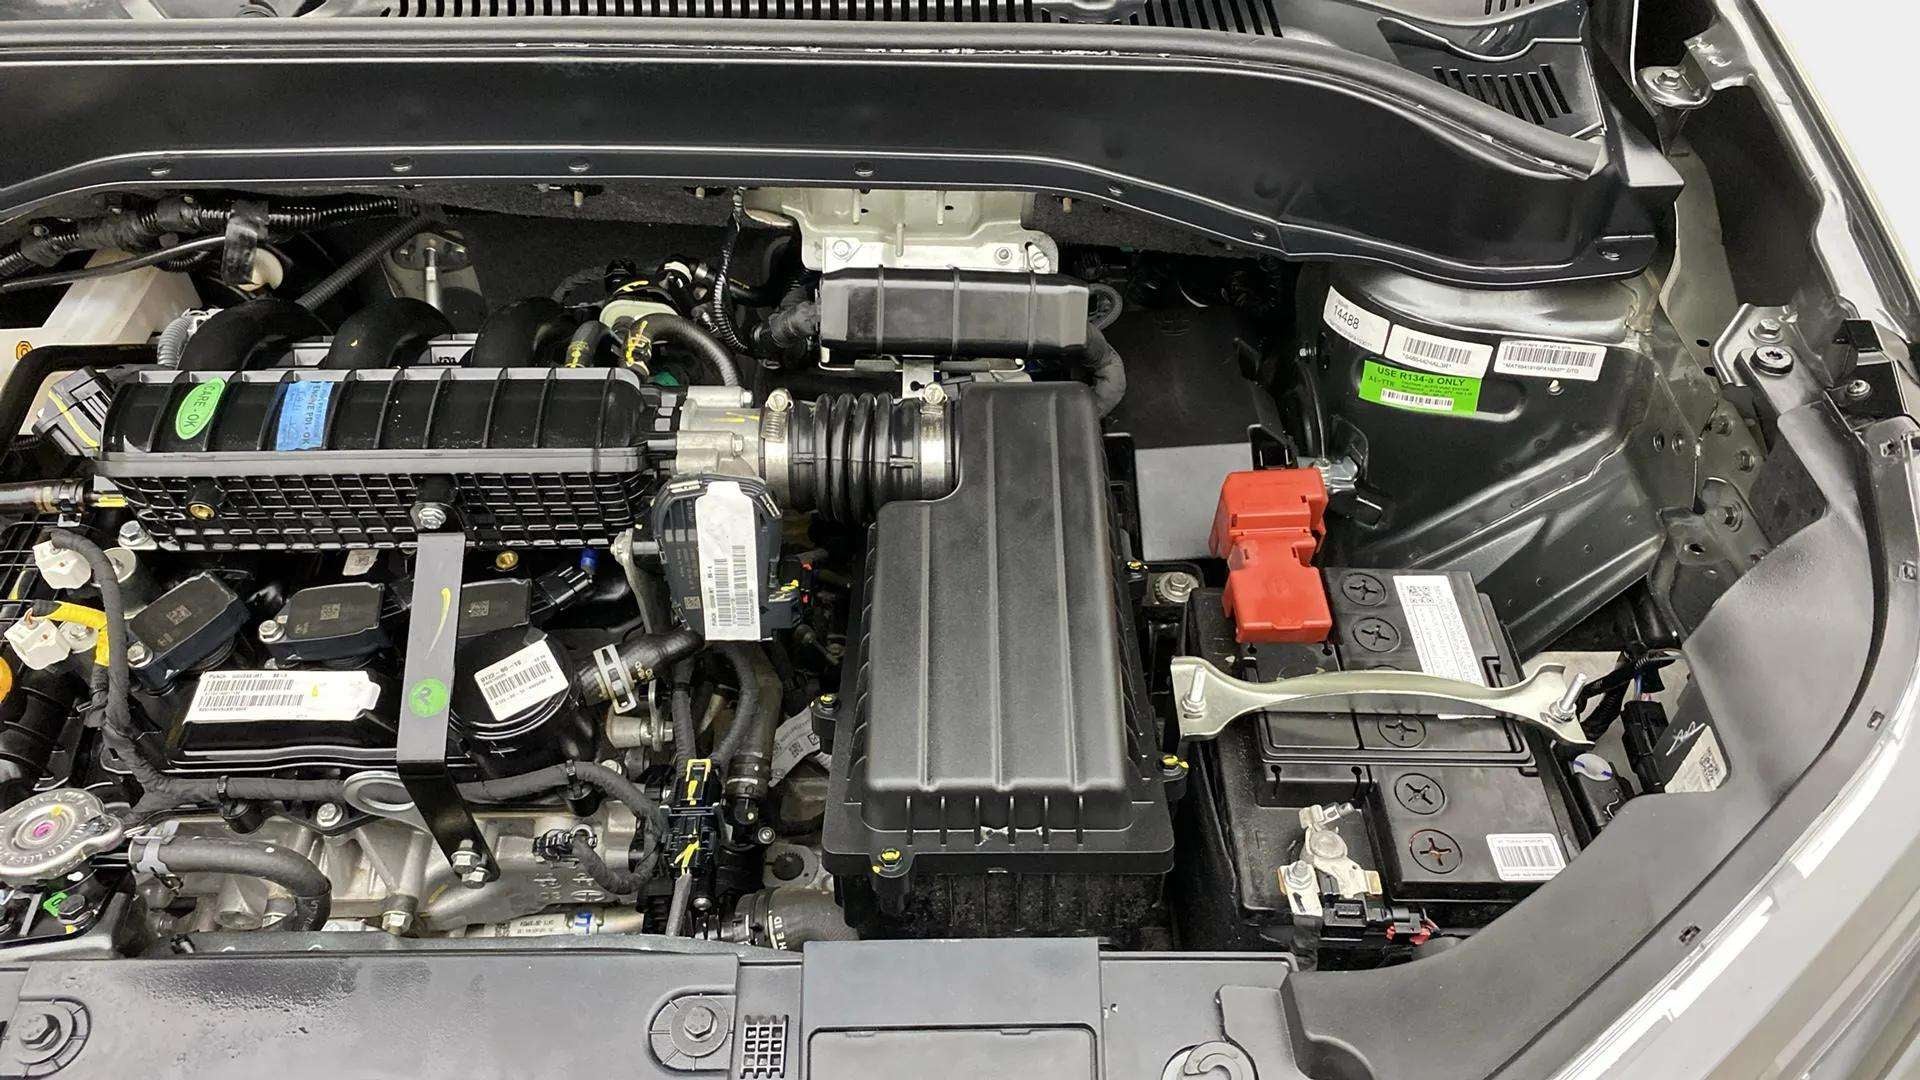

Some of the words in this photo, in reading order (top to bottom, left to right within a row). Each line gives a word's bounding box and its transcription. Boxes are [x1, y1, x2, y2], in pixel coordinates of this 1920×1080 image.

[1377, 366, 1397, 378] USE
[1437, 377, 1466, 386] ONLY
[184, 413, 199, 428] OK
[302, 433, 312, 445] OK
